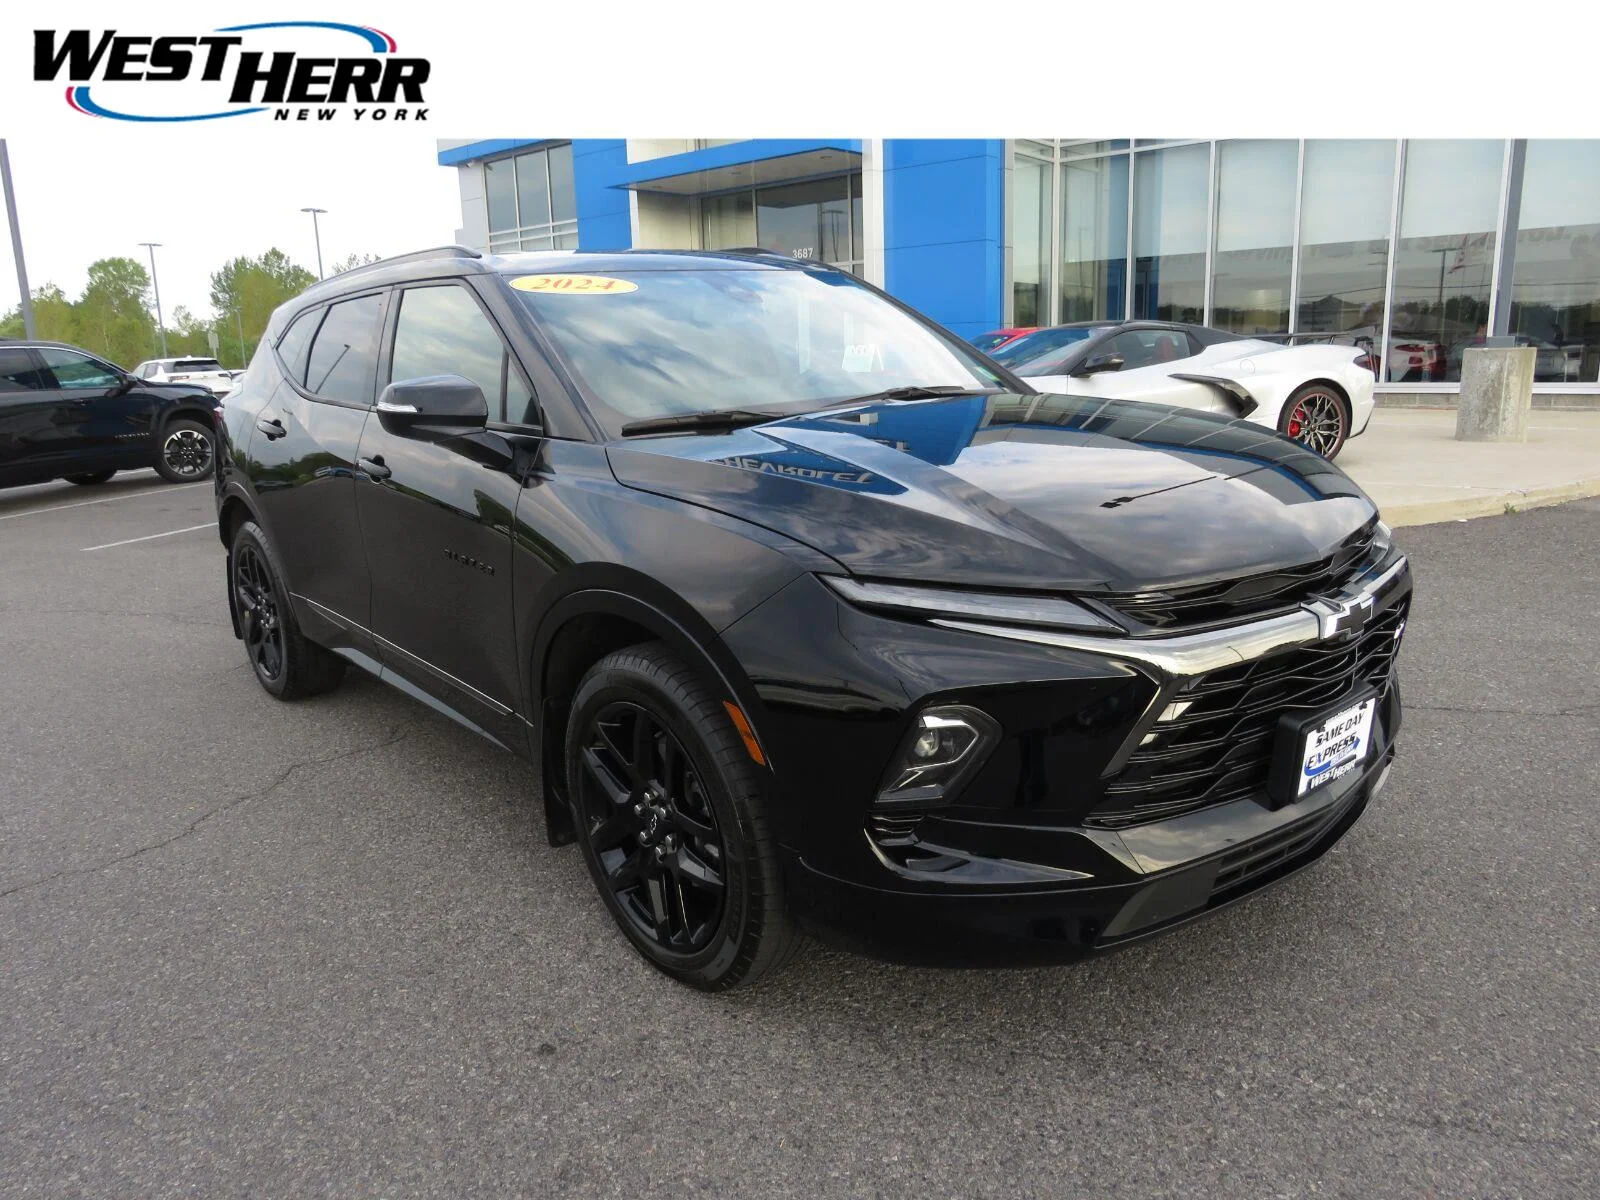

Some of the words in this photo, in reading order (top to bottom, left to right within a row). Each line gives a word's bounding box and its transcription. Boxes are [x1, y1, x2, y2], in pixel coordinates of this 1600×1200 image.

[792, 247, 814, 259] 3687
[531, 278, 616, 290] 2024
[1315, 722, 1344, 748] SAME
[1344, 711, 1365, 732] DAY
